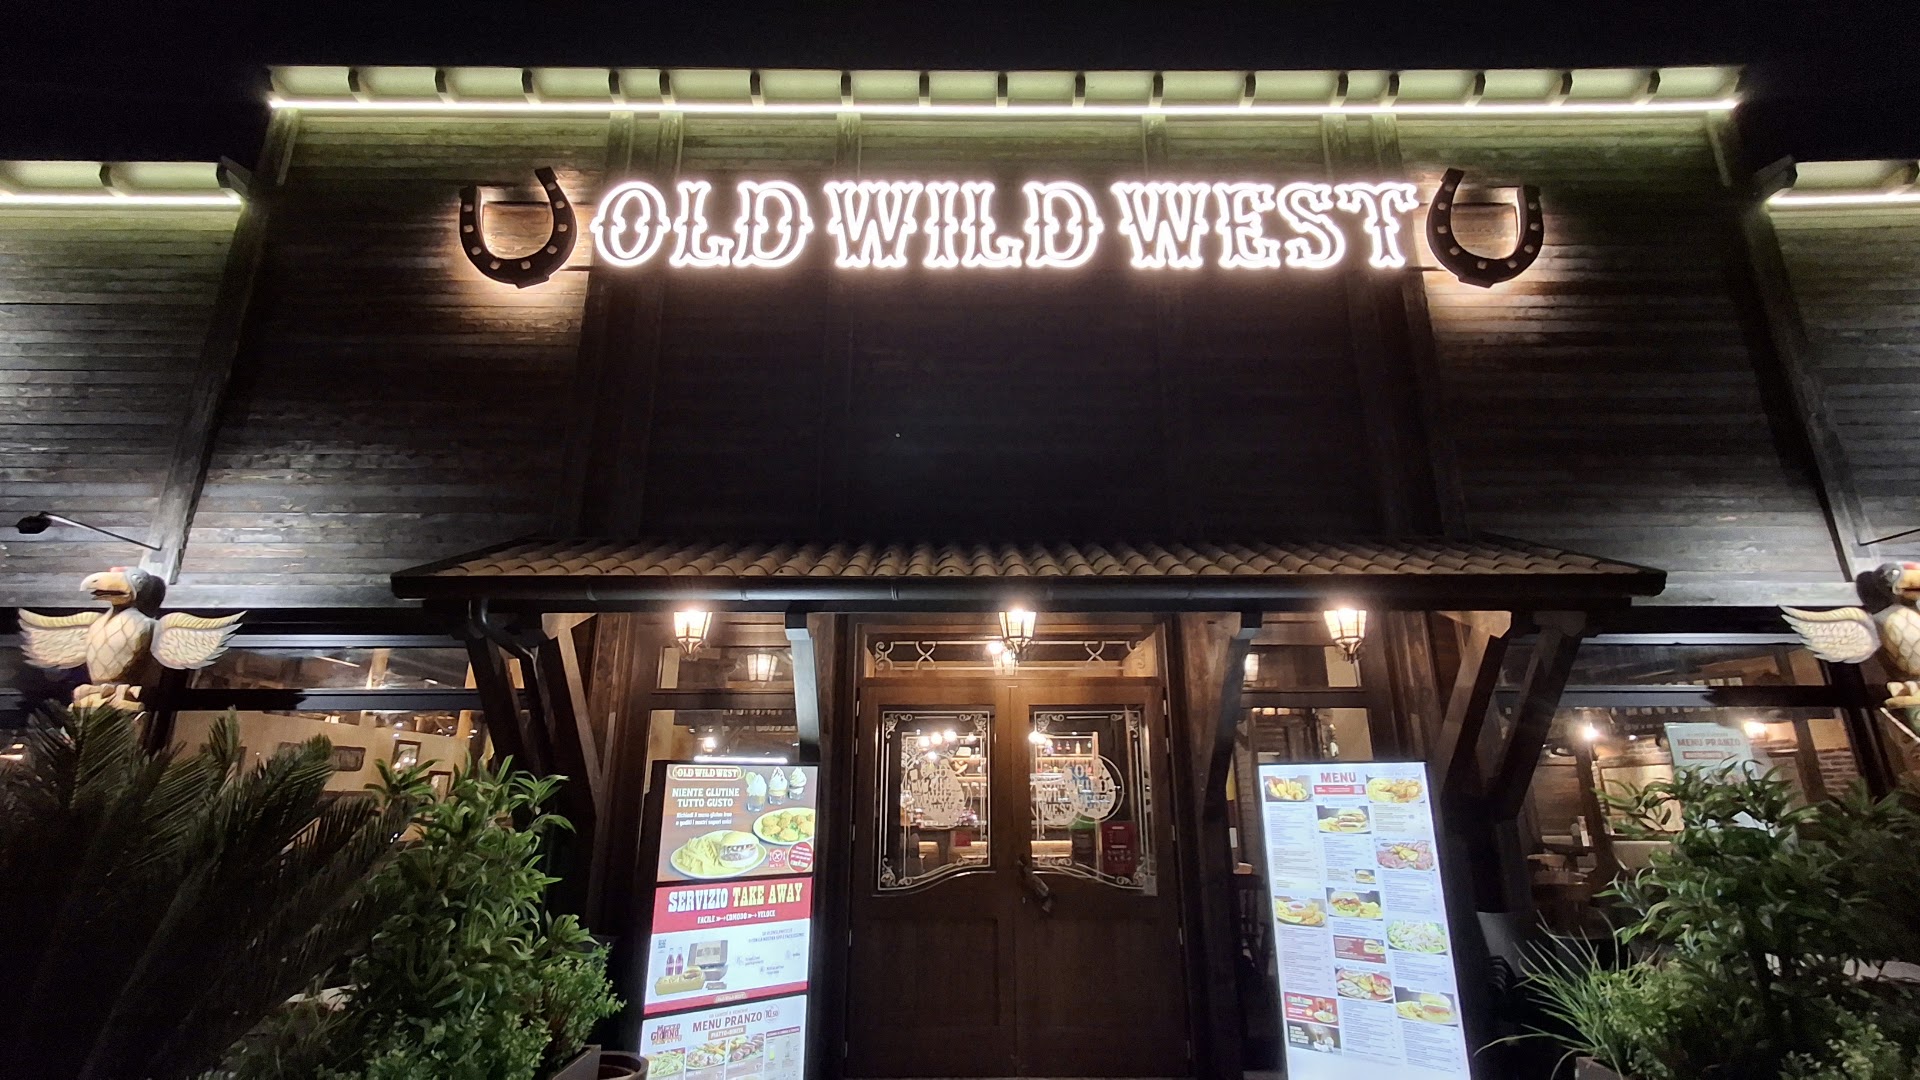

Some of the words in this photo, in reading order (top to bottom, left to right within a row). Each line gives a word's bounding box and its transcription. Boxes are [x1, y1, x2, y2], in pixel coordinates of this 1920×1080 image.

[590, 181, 814, 268] OLD
[823, 180, 1104, 268] WILD
[1110, 180, 1420, 269] WEST
[1677, 738, 1703, 746] MENU
[1705, 738, 1740, 746] PRANZO
[677, 768, 693, 777] OLD
[695, 769, 716, 777] WILD
[716, 769, 738, 777] WEST
[1320, 772, 1356, 783] MENU
[672, 788, 703, 797] NIENTE
[705, 788, 740, 797] GLUTINE
[677, 798, 705, 808] TUTTO
[707, 798, 734, 808] GUSTO
[668, 888, 729, 913] SERVIZIO
[733, 885, 764, 908] TAKE
[768, 882, 804, 904] AWAY
[697, 914, 716, 924] FACILE
[725, 911, 748, 922] COMODO
[757, 909, 776, 918] VELOCE
[692, 1019, 722, 1033] MENU
[724, 1012, 762, 1028] PRANZO
